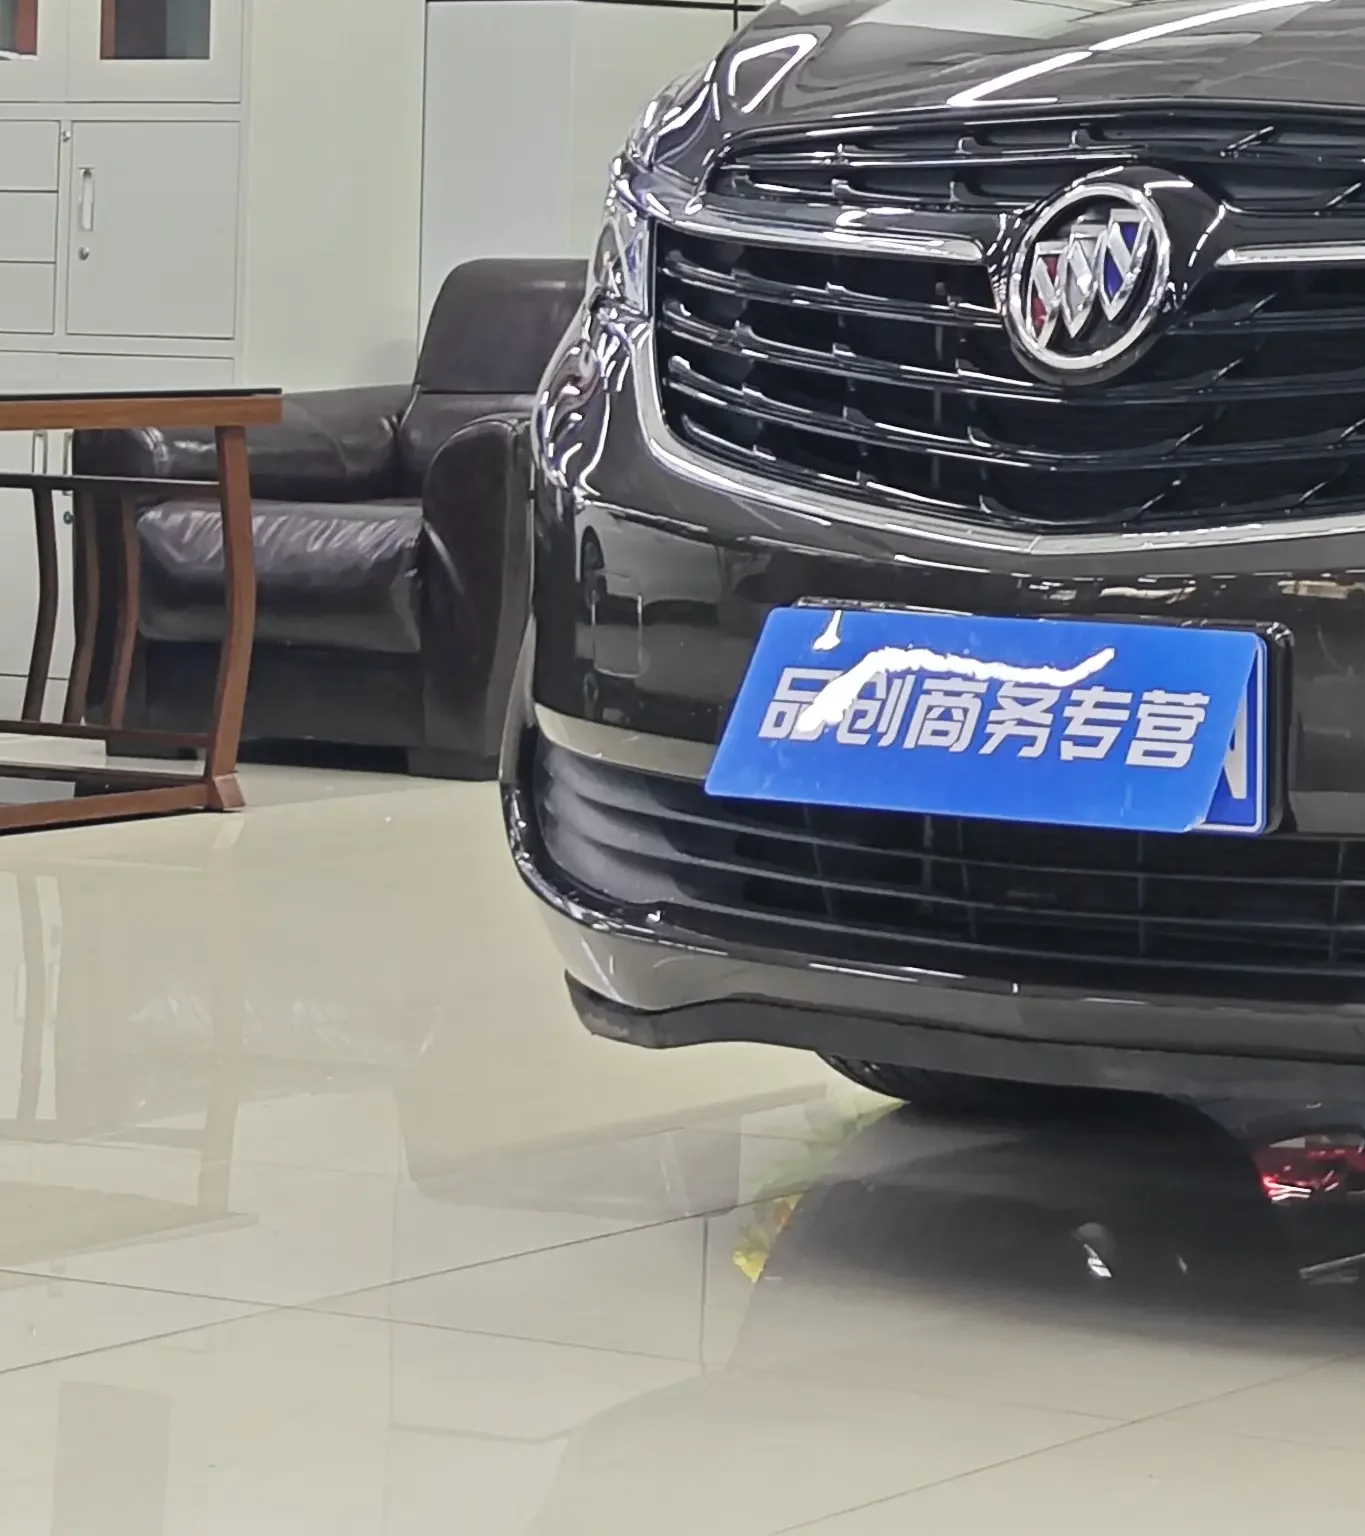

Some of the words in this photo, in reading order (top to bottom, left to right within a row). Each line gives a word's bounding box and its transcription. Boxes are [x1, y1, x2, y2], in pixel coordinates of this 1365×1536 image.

[757, 666, 1211, 769] 品创商务专营
